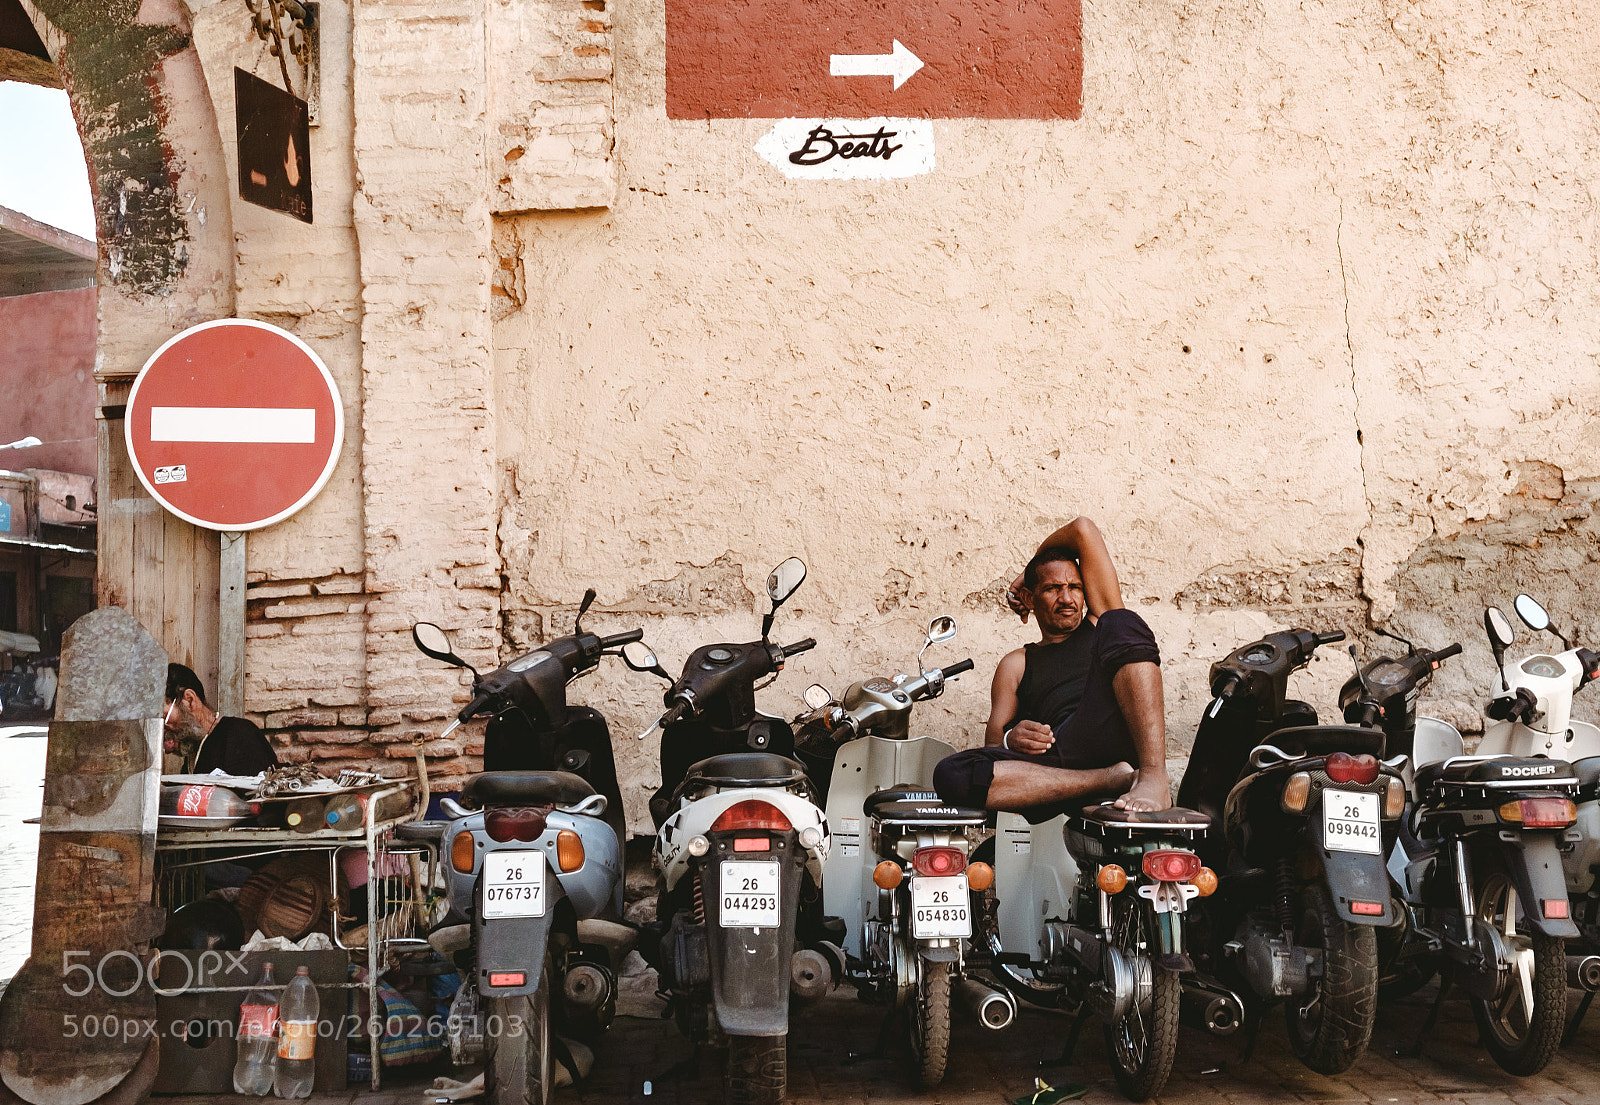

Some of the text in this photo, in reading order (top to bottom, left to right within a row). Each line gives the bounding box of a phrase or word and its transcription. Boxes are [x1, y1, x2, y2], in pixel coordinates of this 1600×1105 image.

[788, 124, 903, 166] Beats
[1502, 765, 1556, 776] DOCKER
[905, 792, 938, 801] YAMAHA
[916, 807, 959, 815] YAMAHA
[1344, 806, 1360, 818] 26
[1328, 822, 1377, 839] 099442
[506, 868, 523, 881] 26
[742, 878, 758, 891] 26
[487, 886, 541, 901] 076737
[933, 891, 949, 903] 26
[724, 897, 776, 911] 044293
[917, 909, 967, 922] 054830
